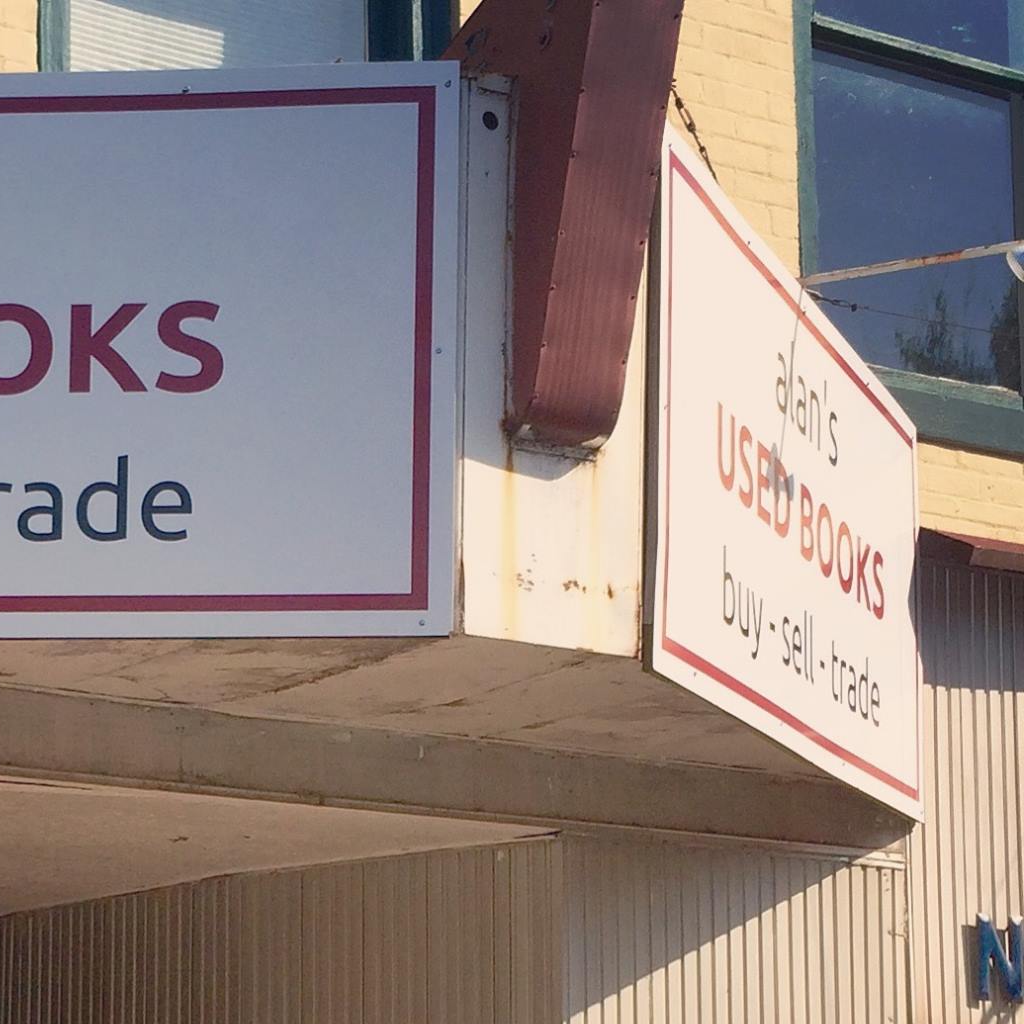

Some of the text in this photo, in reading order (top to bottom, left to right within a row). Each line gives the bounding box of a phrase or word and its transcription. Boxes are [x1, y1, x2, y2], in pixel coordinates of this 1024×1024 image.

[776, 341, 838, 467] alan's
[717, 401, 885, 621] USED BOOKS
[723, 545, 764, 660] buy
[781, 610, 815, 685] sell
[832, 640, 881, 728] trade
